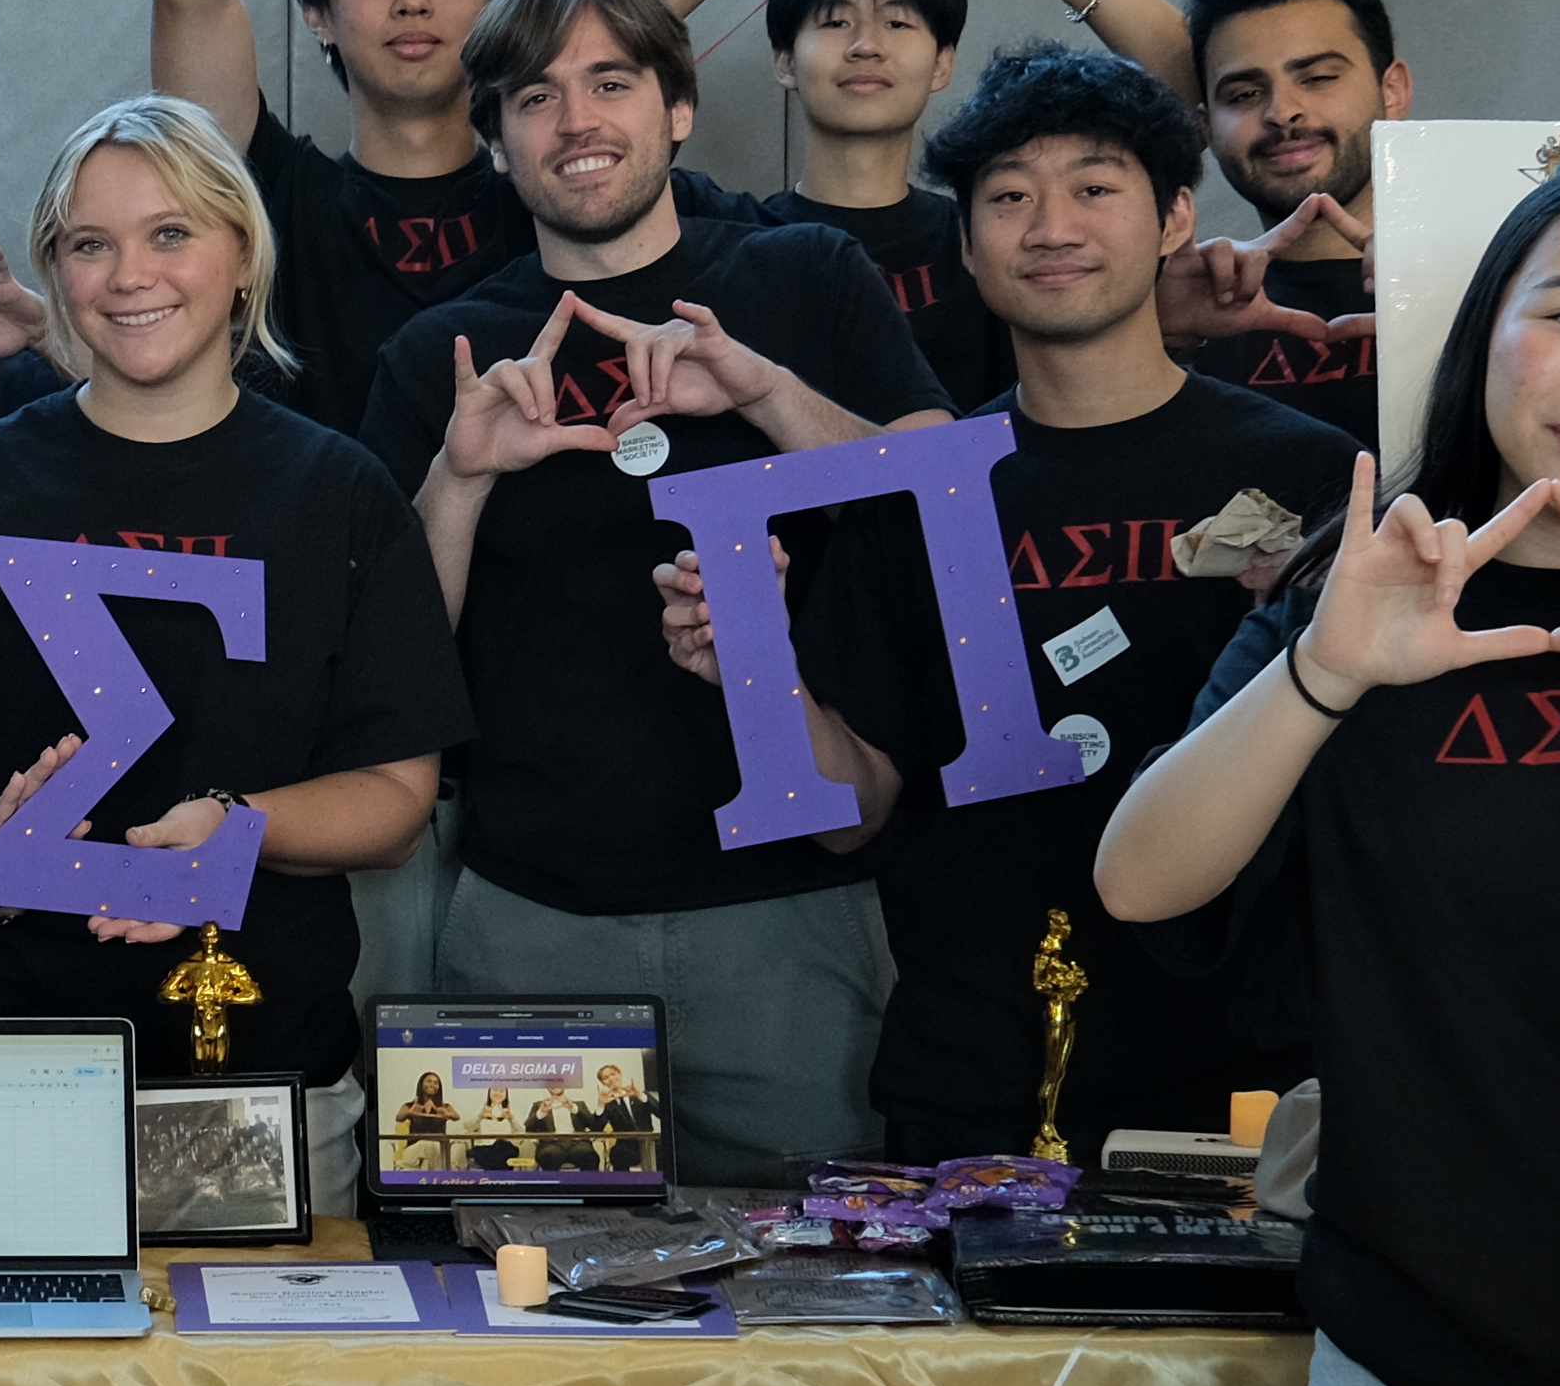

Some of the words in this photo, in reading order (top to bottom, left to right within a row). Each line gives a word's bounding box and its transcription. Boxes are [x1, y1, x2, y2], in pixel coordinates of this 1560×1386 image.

[1011, 518, 1184, 590] ΔΣΠ
[461, 1063, 506, 1075] DELTA
[510, 1063, 557, 1075] SIGMA
[561, 1063, 576, 1075] PI
